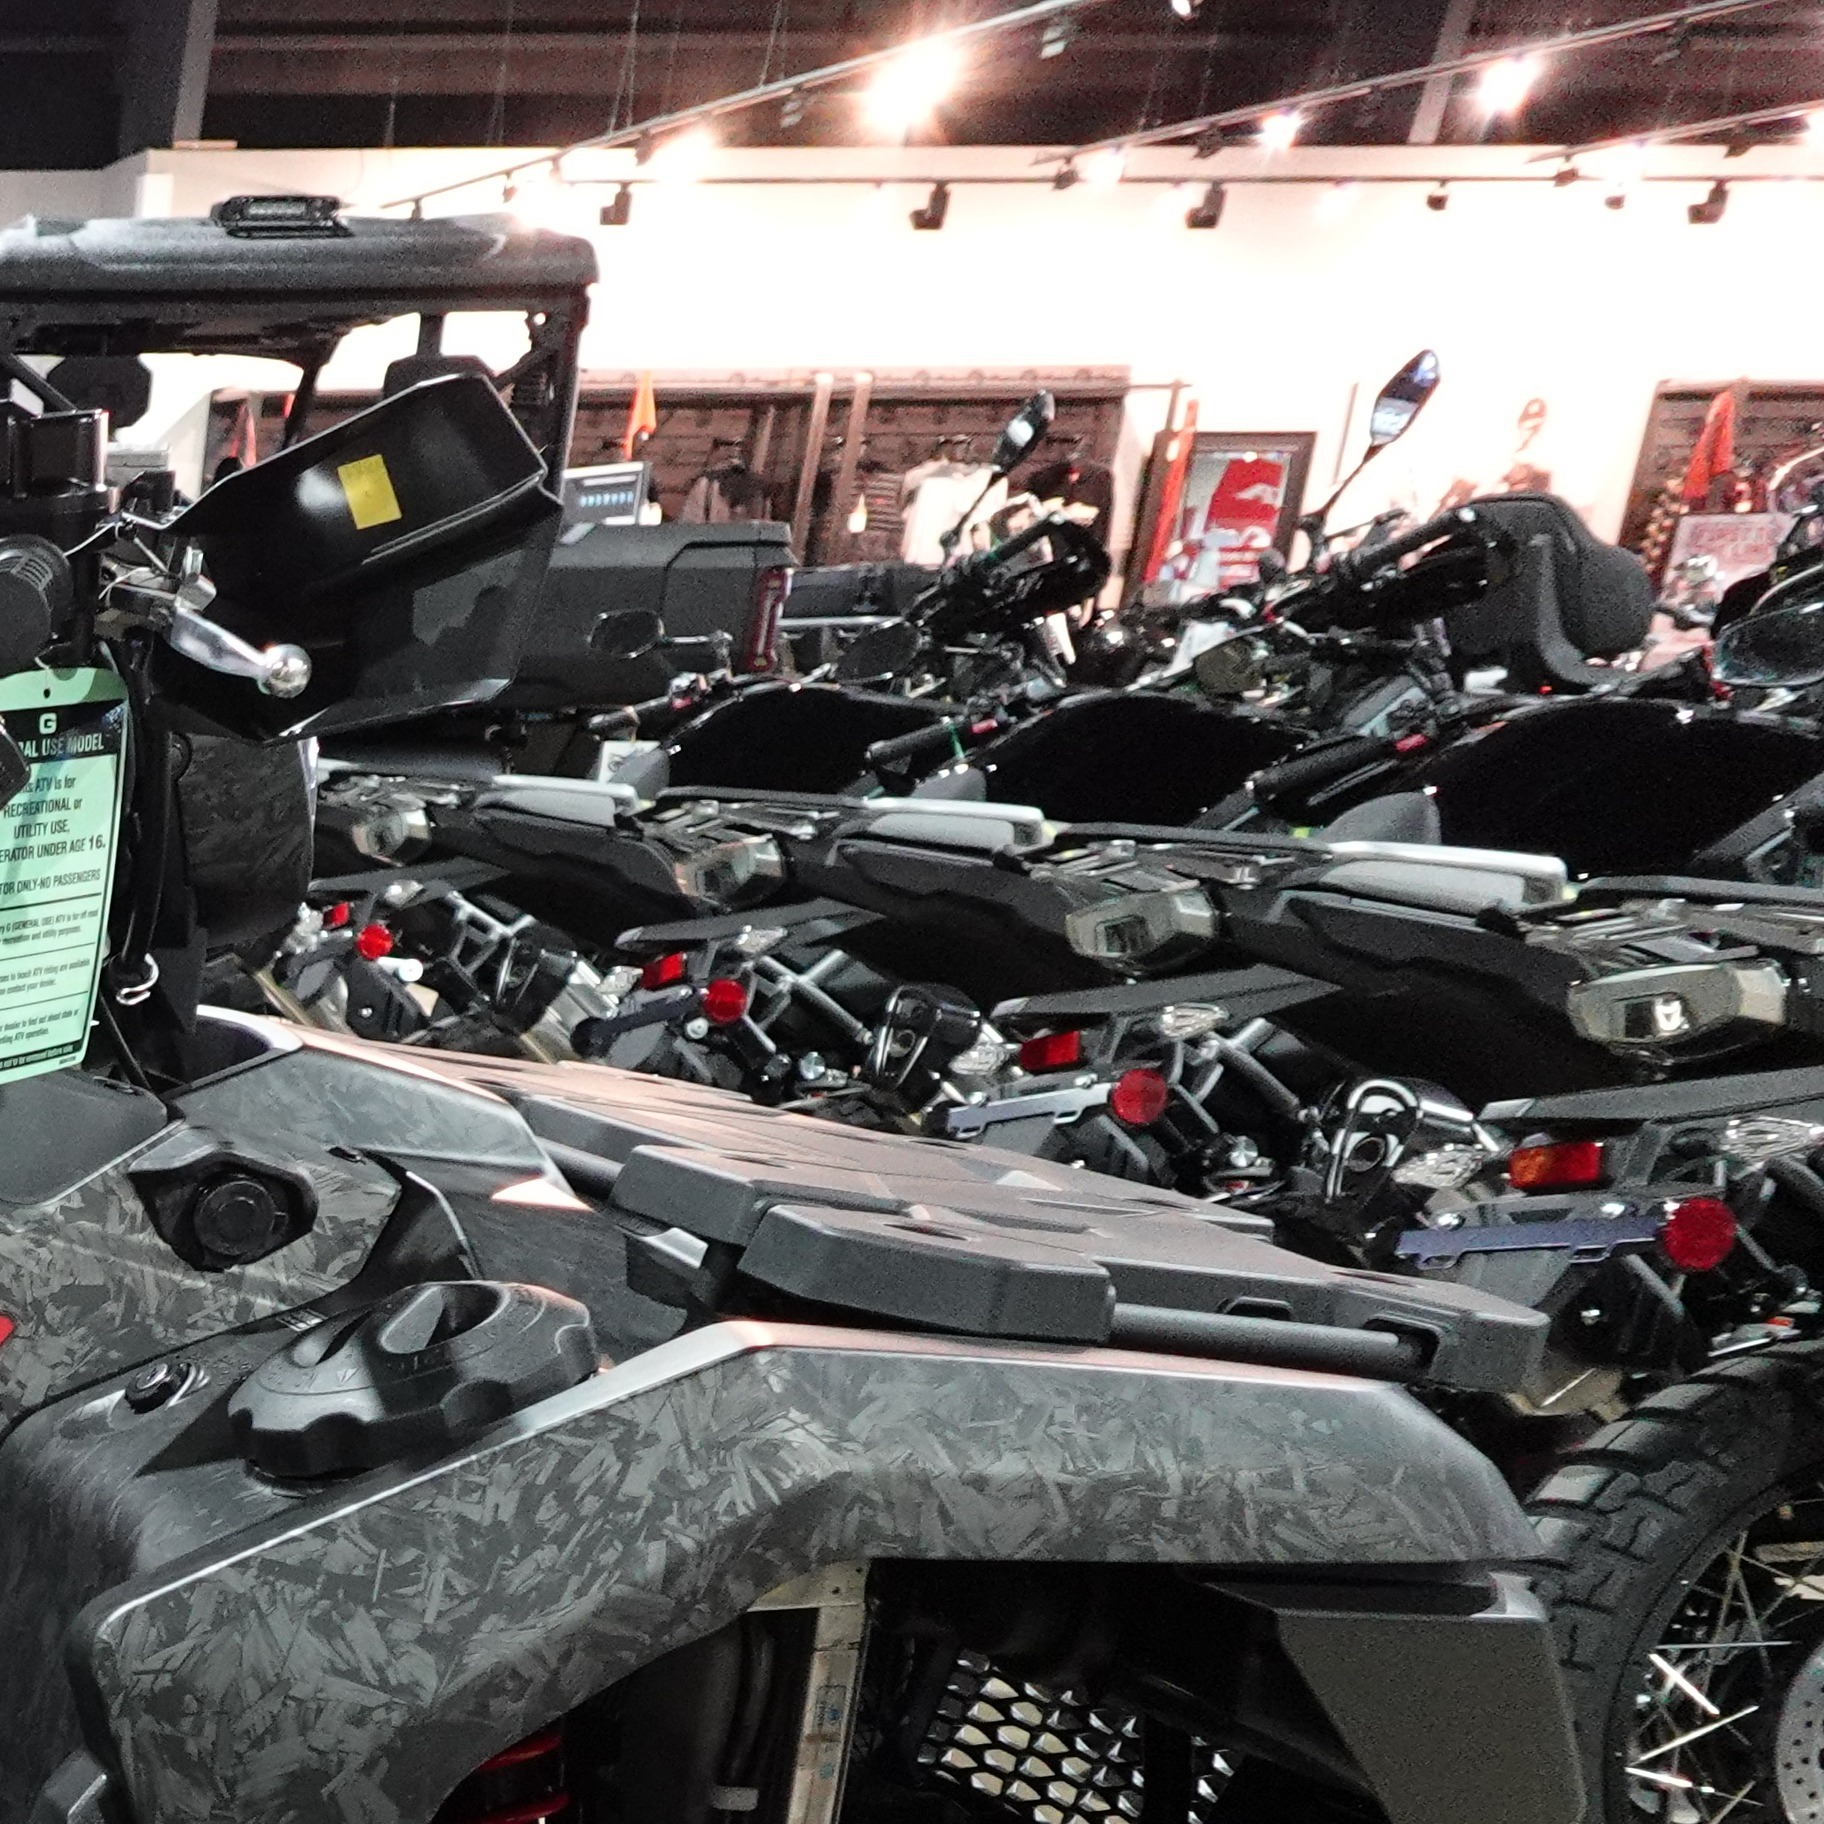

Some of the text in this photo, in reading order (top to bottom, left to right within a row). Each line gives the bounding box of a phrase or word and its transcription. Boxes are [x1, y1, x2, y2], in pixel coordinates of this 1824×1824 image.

[38, 712, 58, 735] G
[41, 737, 65, 757] USE
[67, 732, 105, 755] MODEL
[35, 777, 52, 793] ATV
[64, 774, 77, 790] for
[3, 798, 83, 819] RECREATIONAL or
[13, 822, 49, 840] UTILITY
[36, 840, 68, 859] UNDER
[68, 838, 86, 854] AGE
[52, 868, 102, 888] PASSENGERS
